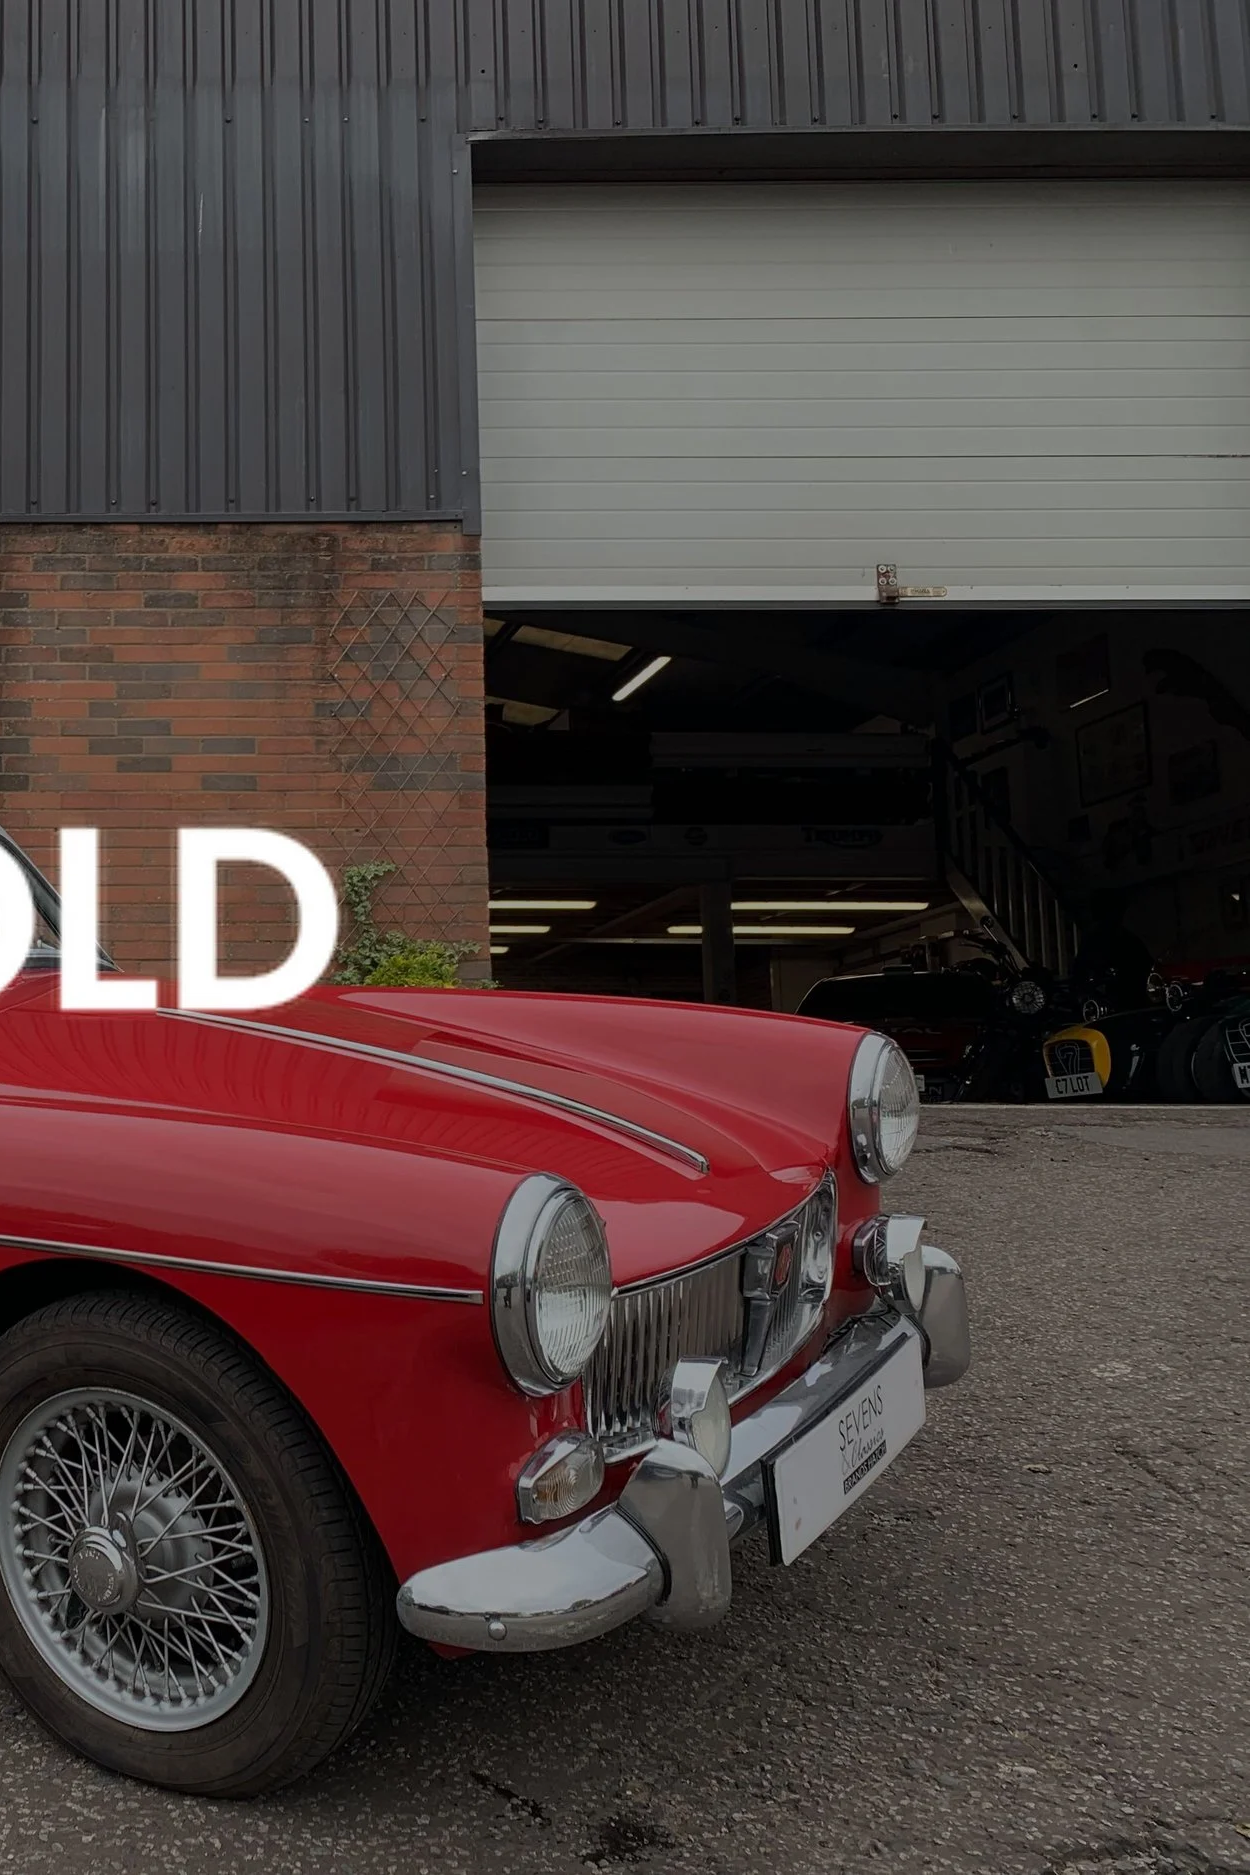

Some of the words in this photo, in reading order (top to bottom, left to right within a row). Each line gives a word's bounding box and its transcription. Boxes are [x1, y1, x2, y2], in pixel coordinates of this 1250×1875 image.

[839, 1385, 883, 1452] SEVENS
[844, 1459, 869, 1492] BRANDS
[868, 1441, 886, 1469] HATCH
